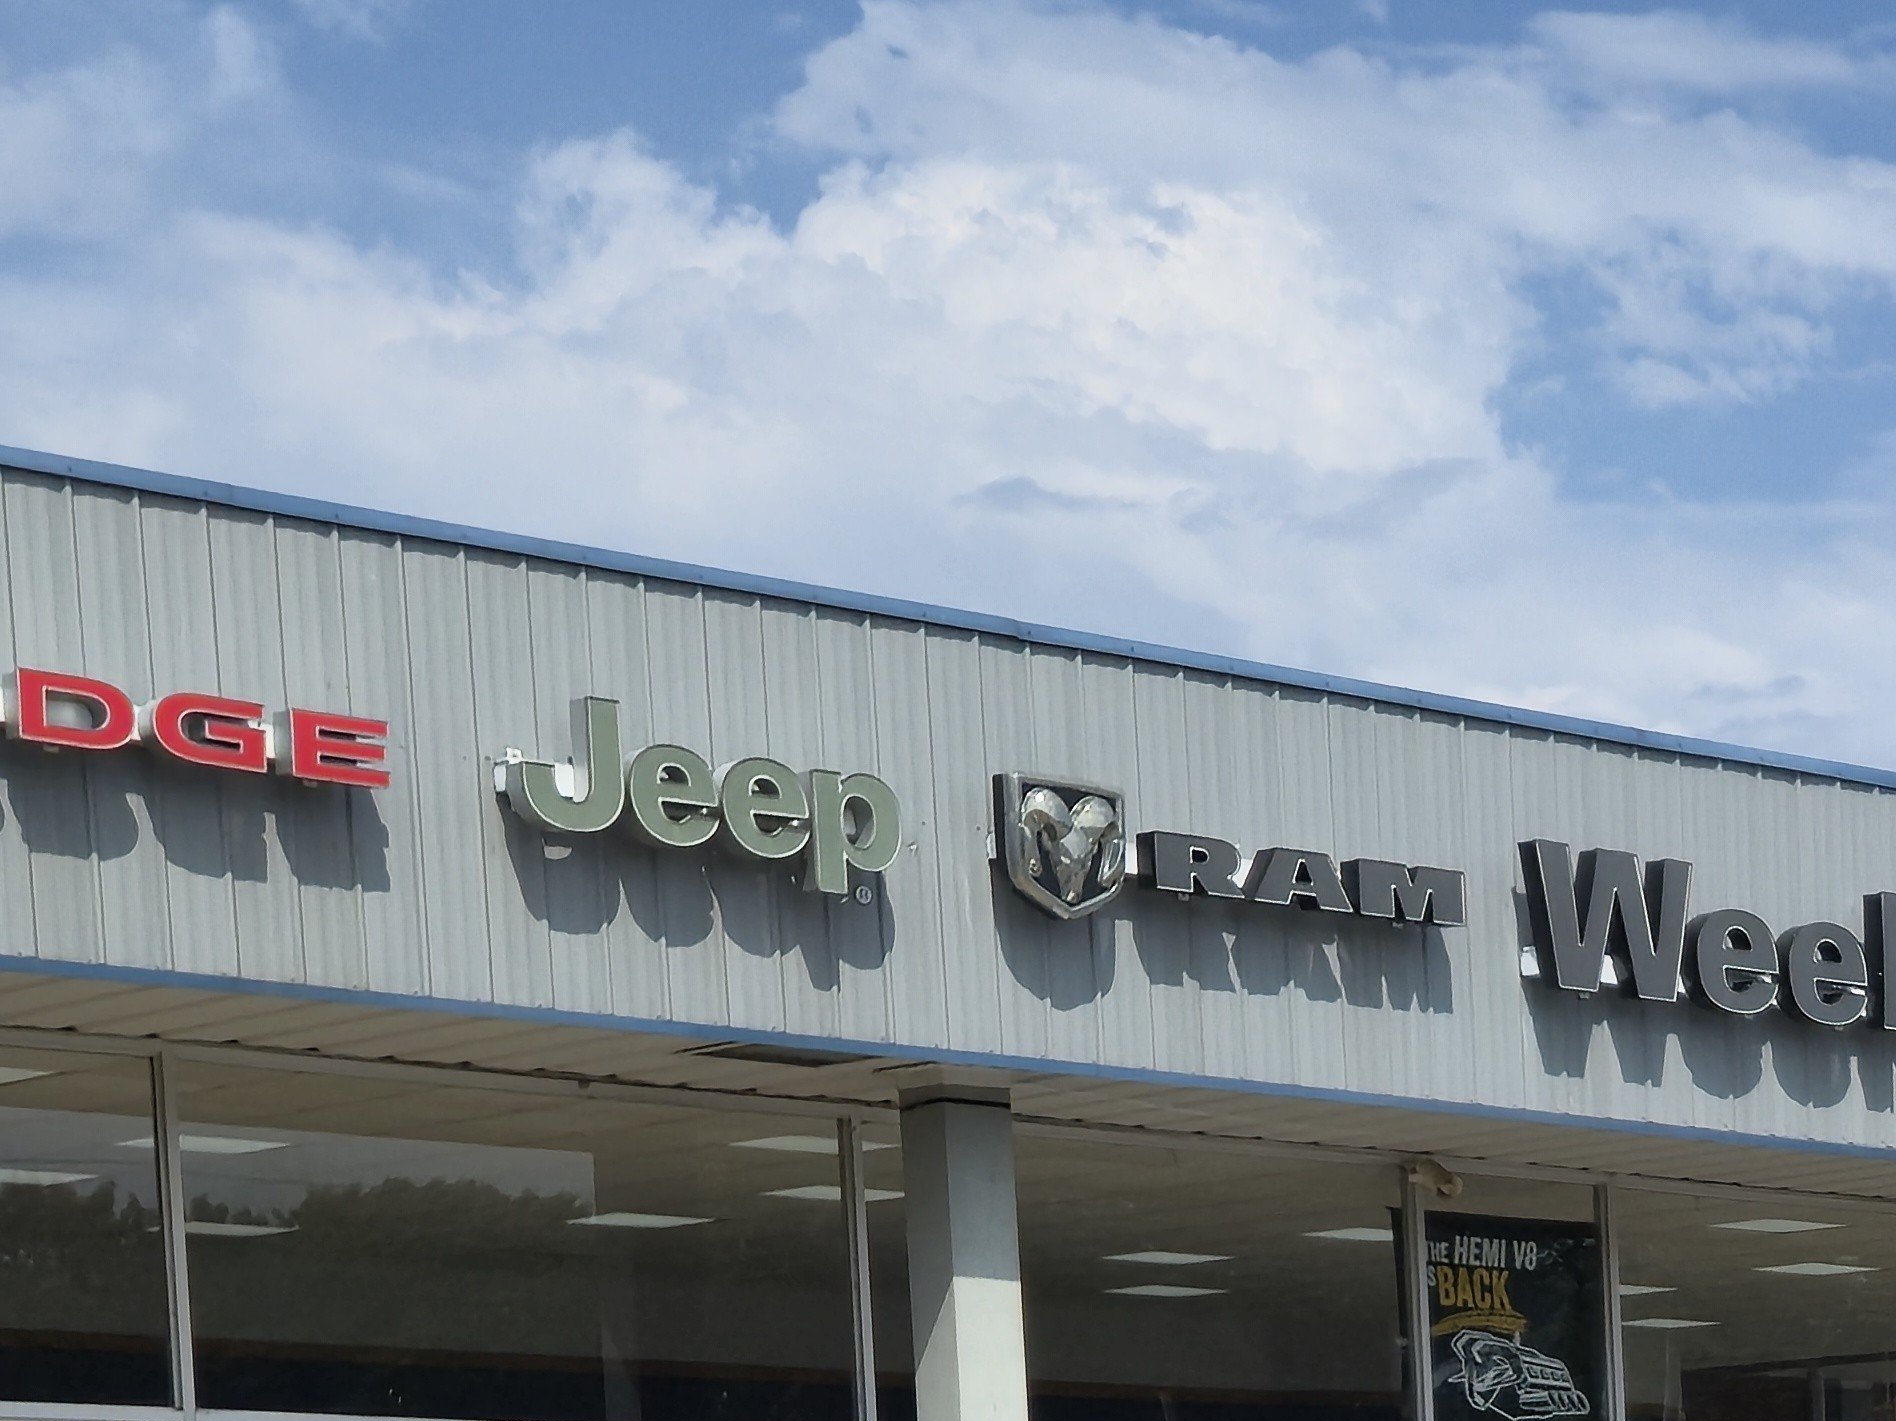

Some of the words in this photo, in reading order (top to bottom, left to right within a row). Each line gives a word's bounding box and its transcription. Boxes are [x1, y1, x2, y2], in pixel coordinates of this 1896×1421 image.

[14, 667, 390, 788] DGE
[496, 696, 902, 895] Jeep
[1136, 830, 1468, 927] RAM
[1428, 1240, 1450, 1263] HE
[1454, 1234, 1507, 1269] HEMI
[1512, 1240, 1538, 1271] V8
[1437, 1265, 1513, 1314] BACK
